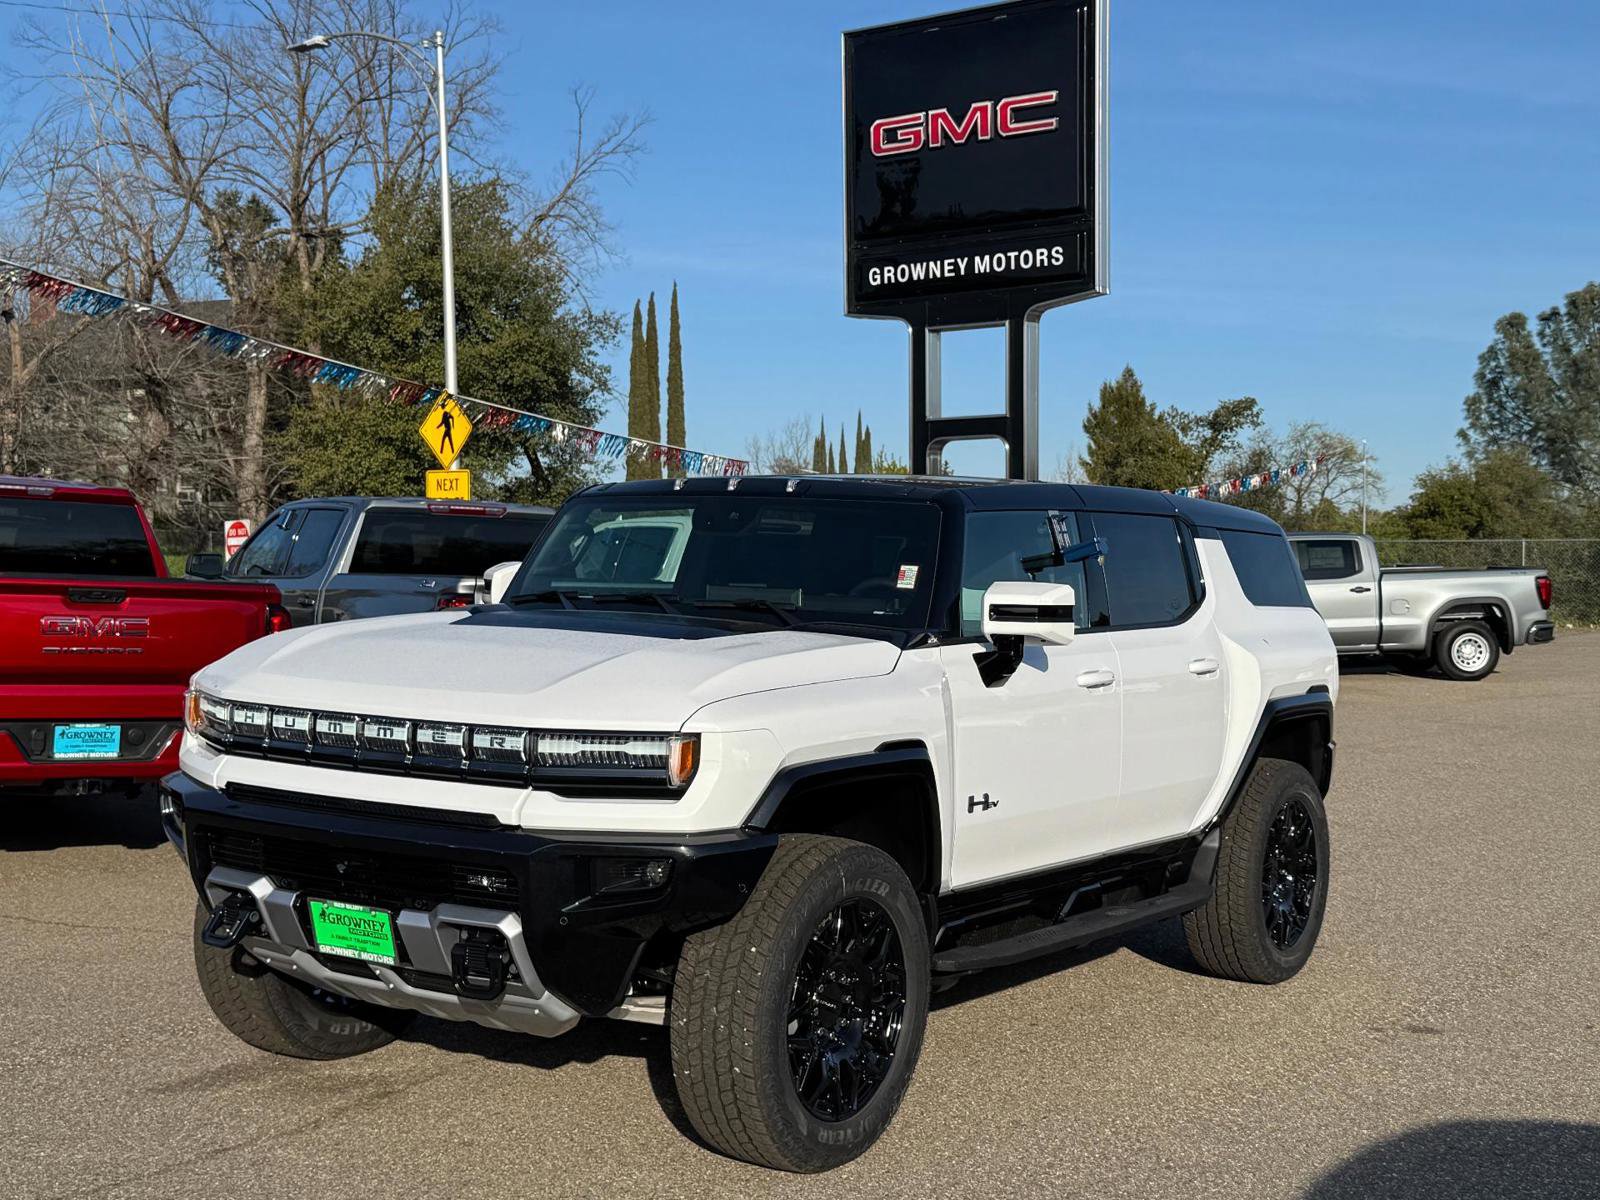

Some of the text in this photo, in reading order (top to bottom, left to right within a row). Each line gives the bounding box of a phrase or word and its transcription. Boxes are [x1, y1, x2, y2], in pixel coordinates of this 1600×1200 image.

[870, 90, 1059, 156] GMC
[868, 246, 1064, 285] GROWNEY MOTORS
[436, 478, 459, 491] NEXT
[229, 528, 247, 536] DO NOT
[40, 616, 150, 637] GMC
[66, 731, 115, 740] GROWNEY
[244, 710, 506, 748] HUMMER
[327, 912, 386, 932] GROWNEY
[319, 945, 359, 959] GROWNEY
[361, 951, 395, 965] MOTORS
